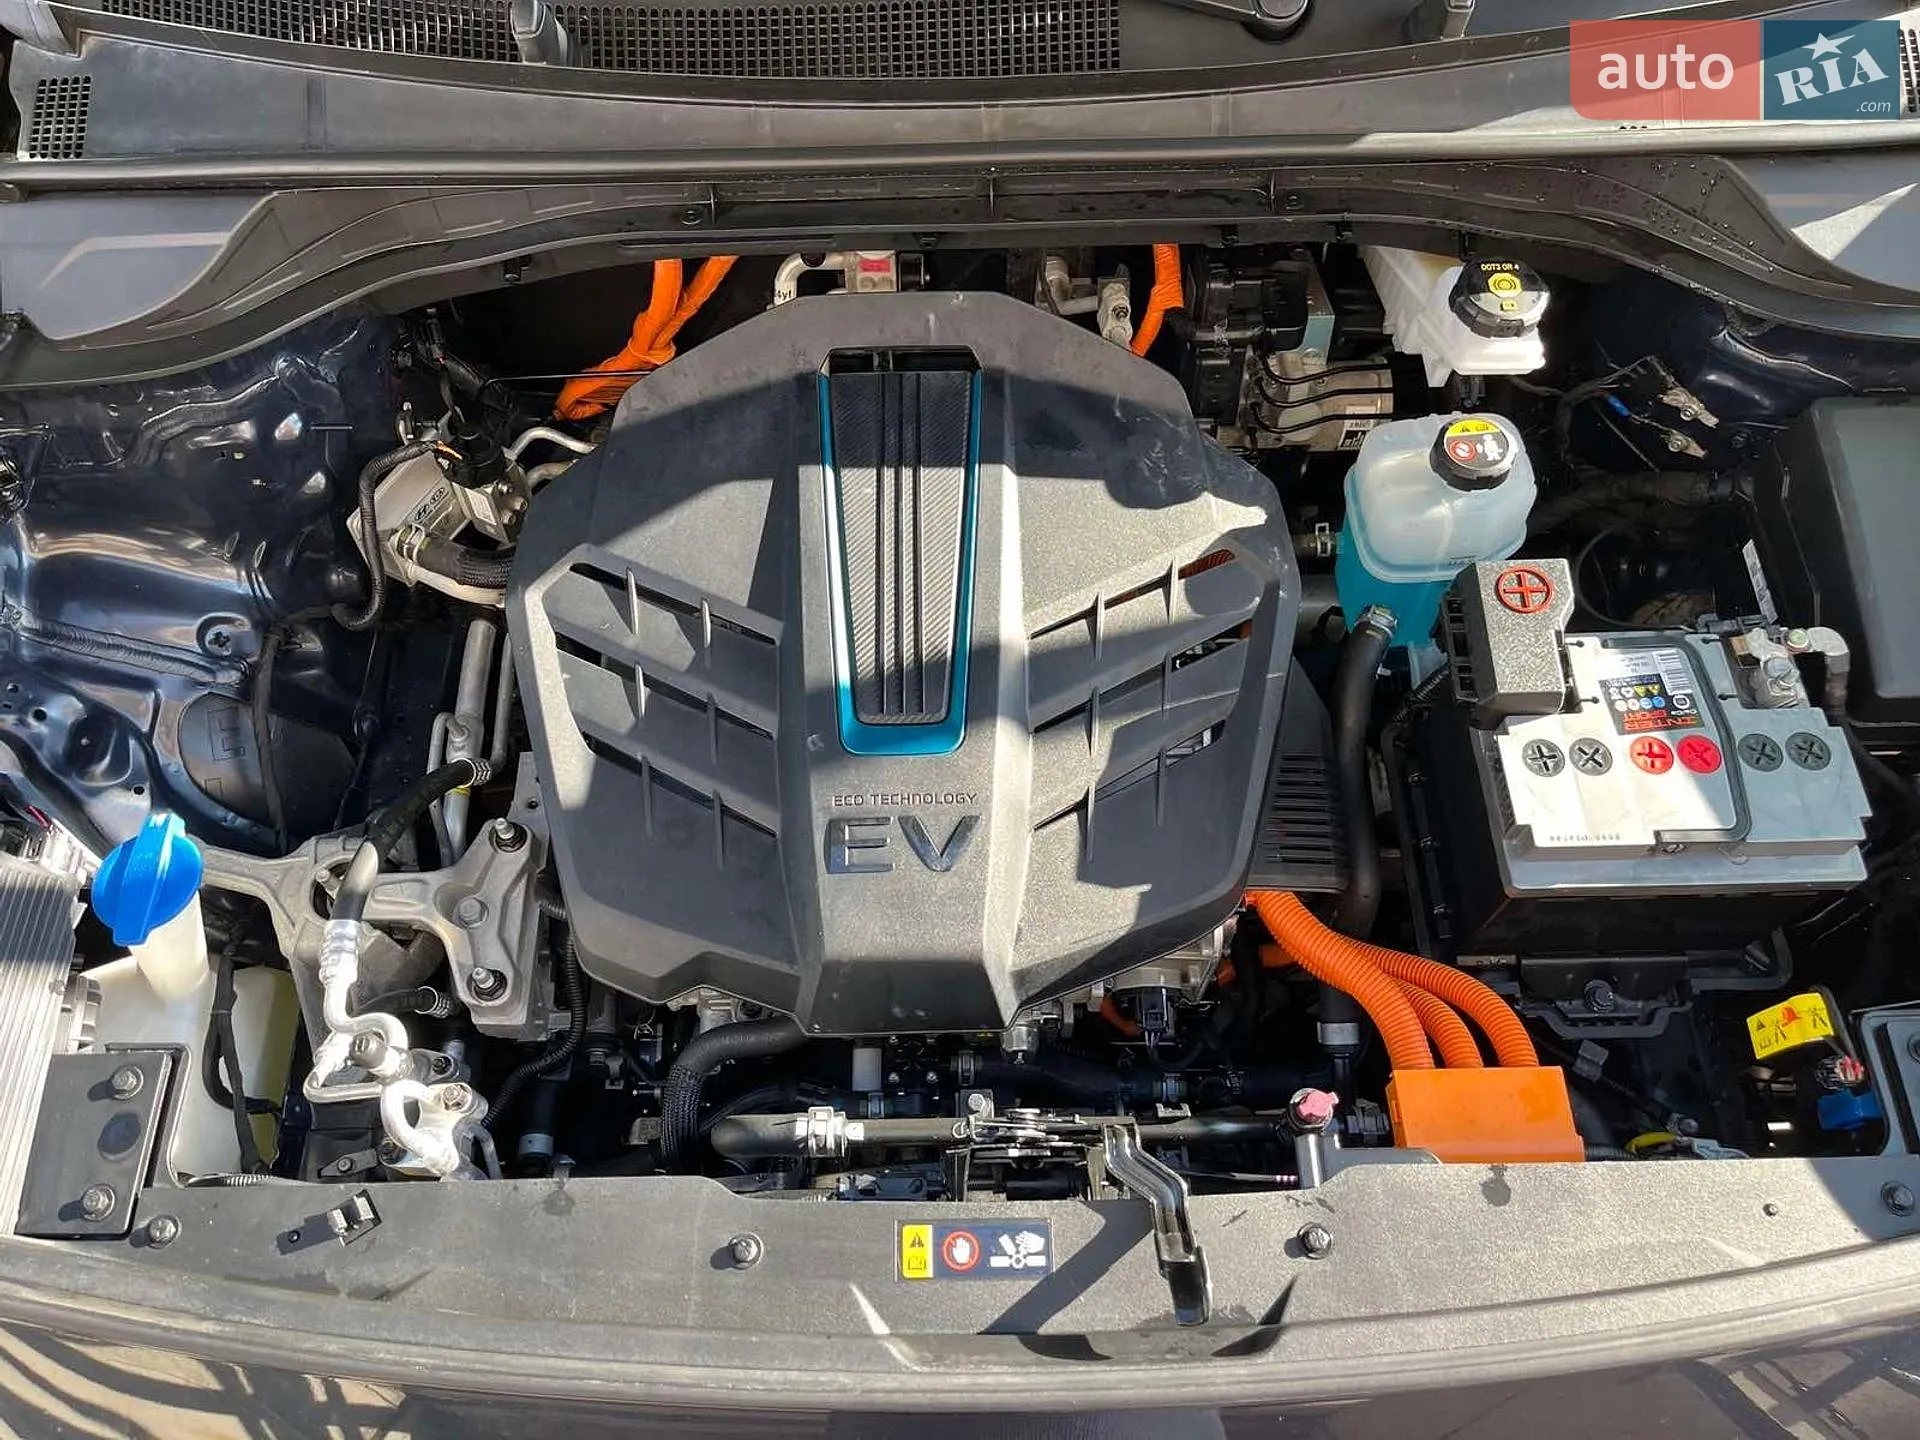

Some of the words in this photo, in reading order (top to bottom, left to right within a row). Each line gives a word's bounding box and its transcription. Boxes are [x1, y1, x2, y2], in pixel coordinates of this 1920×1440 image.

[832, 795, 864, 806] ECO
[869, 793, 977, 806] TECHNOLOGY
[823, 814, 982, 875] EV
